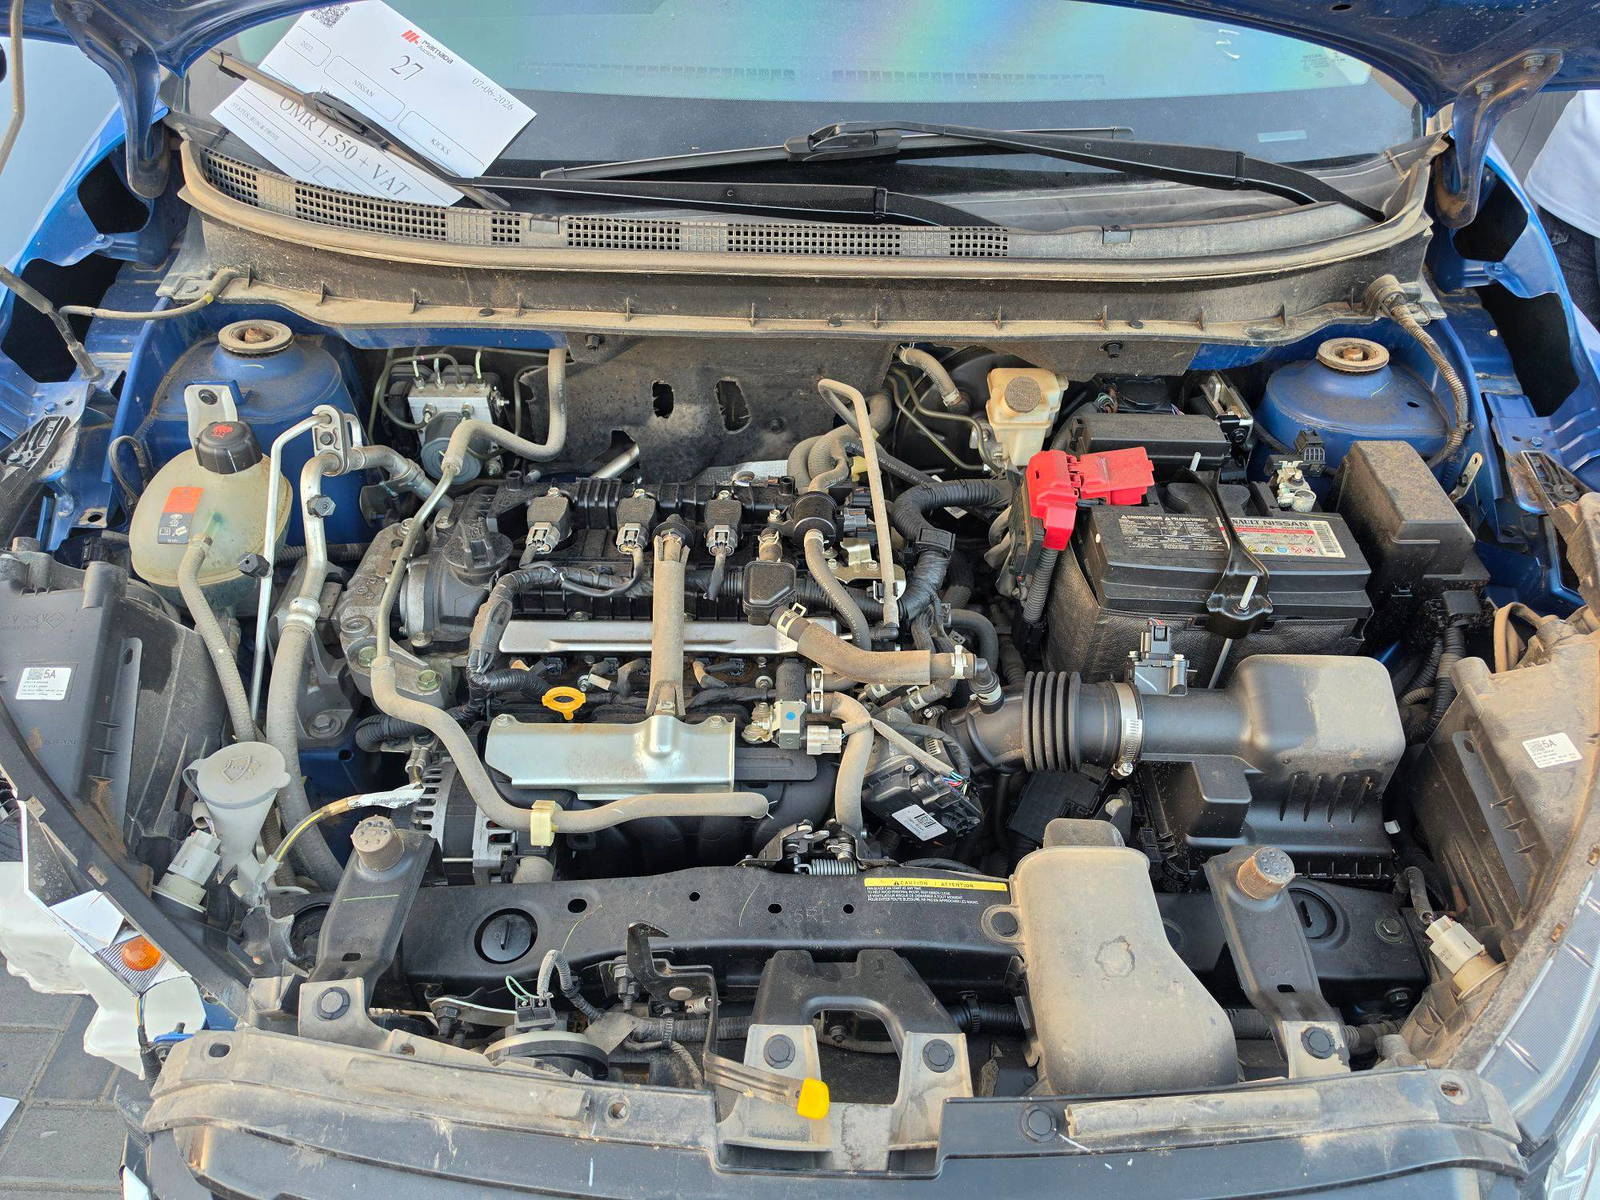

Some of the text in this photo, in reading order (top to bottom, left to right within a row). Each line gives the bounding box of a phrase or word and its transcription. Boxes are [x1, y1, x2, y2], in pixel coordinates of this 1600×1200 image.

[390, 55, 424, 82] 27
[471, 77, 514, 111] 07-06-2026
[280, 97, 410, 197] OMR 1,550 + VAT
[44, 669, 56, 679] 5A
[1541, 739, 1557, 748] 5A
